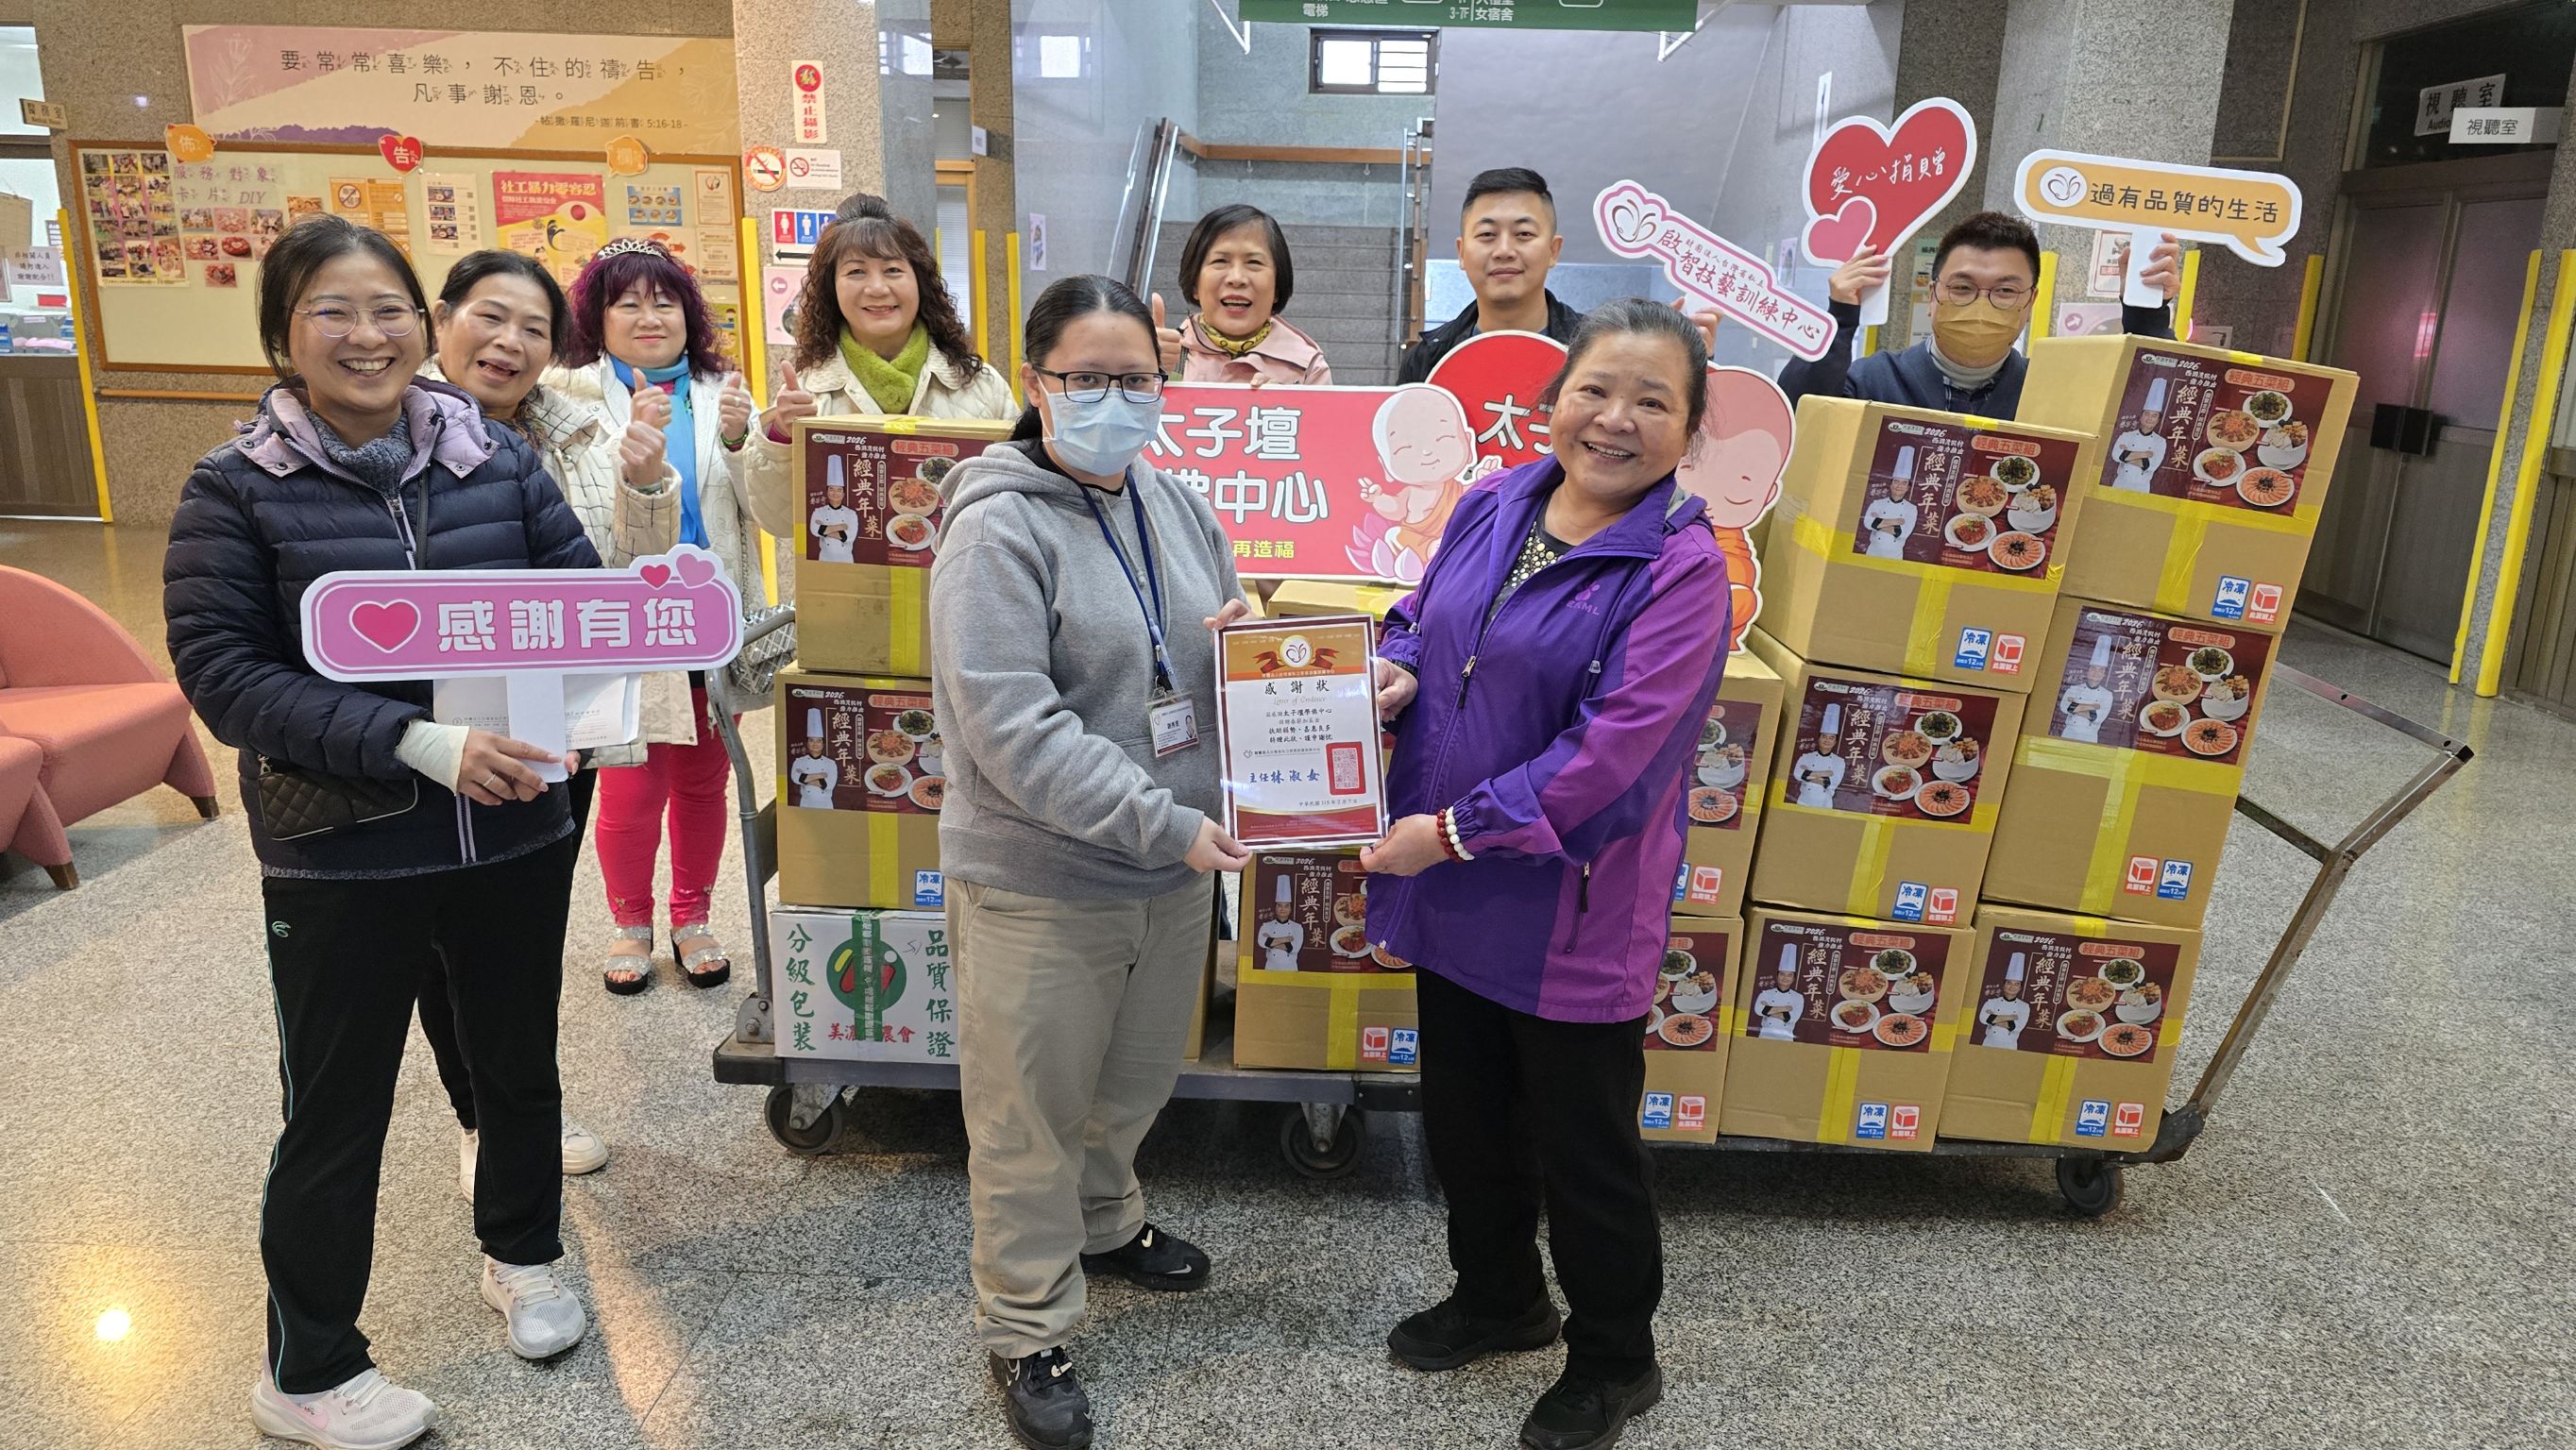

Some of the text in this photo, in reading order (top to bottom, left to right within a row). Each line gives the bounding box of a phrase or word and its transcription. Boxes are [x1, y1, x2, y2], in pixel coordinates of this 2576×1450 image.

[1302, 3, 1329, 17] 電梯
[1475, 8, 1514, 22] 女宿舍
[802, 93, 819, 140] 禁止攝影
[2466, 119, 2518, 136] 視聽室
[393, 146, 411, 164] 告
[1830, 146, 1947, 201] 愛心捐贈
[239, 191, 266, 204] DIY
[2090, 182, 2279, 224] 過有品質的生活
[1657, 228, 1821, 339] 啟智技藝訓練中心
[2178, 360, 2201, 371] 2026
[1924, 427, 1947, 437] 2026
[2167, 384, 2198, 468] 經典年菜
[845, 436, 867, 446] 2026
[852, 458, 883, 537] 經典年菜
[1918, 451, 1945, 534] 經典年菜
[2222, 580, 2246, 594] 冷凍
[436, 597, 697, 652] 感謝有您
[2121, 618, 2144, 629] 2026
[1964, 632, 1989, 646] 冷凍
[1265, 679, 1330, 696] 感謝狀
[2113, 642, 2143, 720] 經典年菜
[831, 712, 860, 784] 經典年菜
[1845, 709, 1871, 784] 經典年菜
[2165, 863, 2189, 876] 冷凍
[919, 873, 941, 885] 冷凍
[1901, 885, 1924, 898] 冷凍
[1299, 878, 1326, 948] 經典年菜
[1805, 927, 1826, 936] 2026
[2033, 936, 2057, 945] 2026
[786, 923, 816, 1051] 分級包裝
[1804, 948, 1828, 1020] 經典年菜
[925, 930, 955, 1057] 品質保證
[2030, 957, 2056, 1030] 經典年菜
[1395, 1031, 1416, 1043] 冷凍
[1648, 1095, 1670, 1106] 冷凍
[1862, 1105, 1885, 1117] 冷凍
[2084, 1104, 2107, 1115] 冷凍
